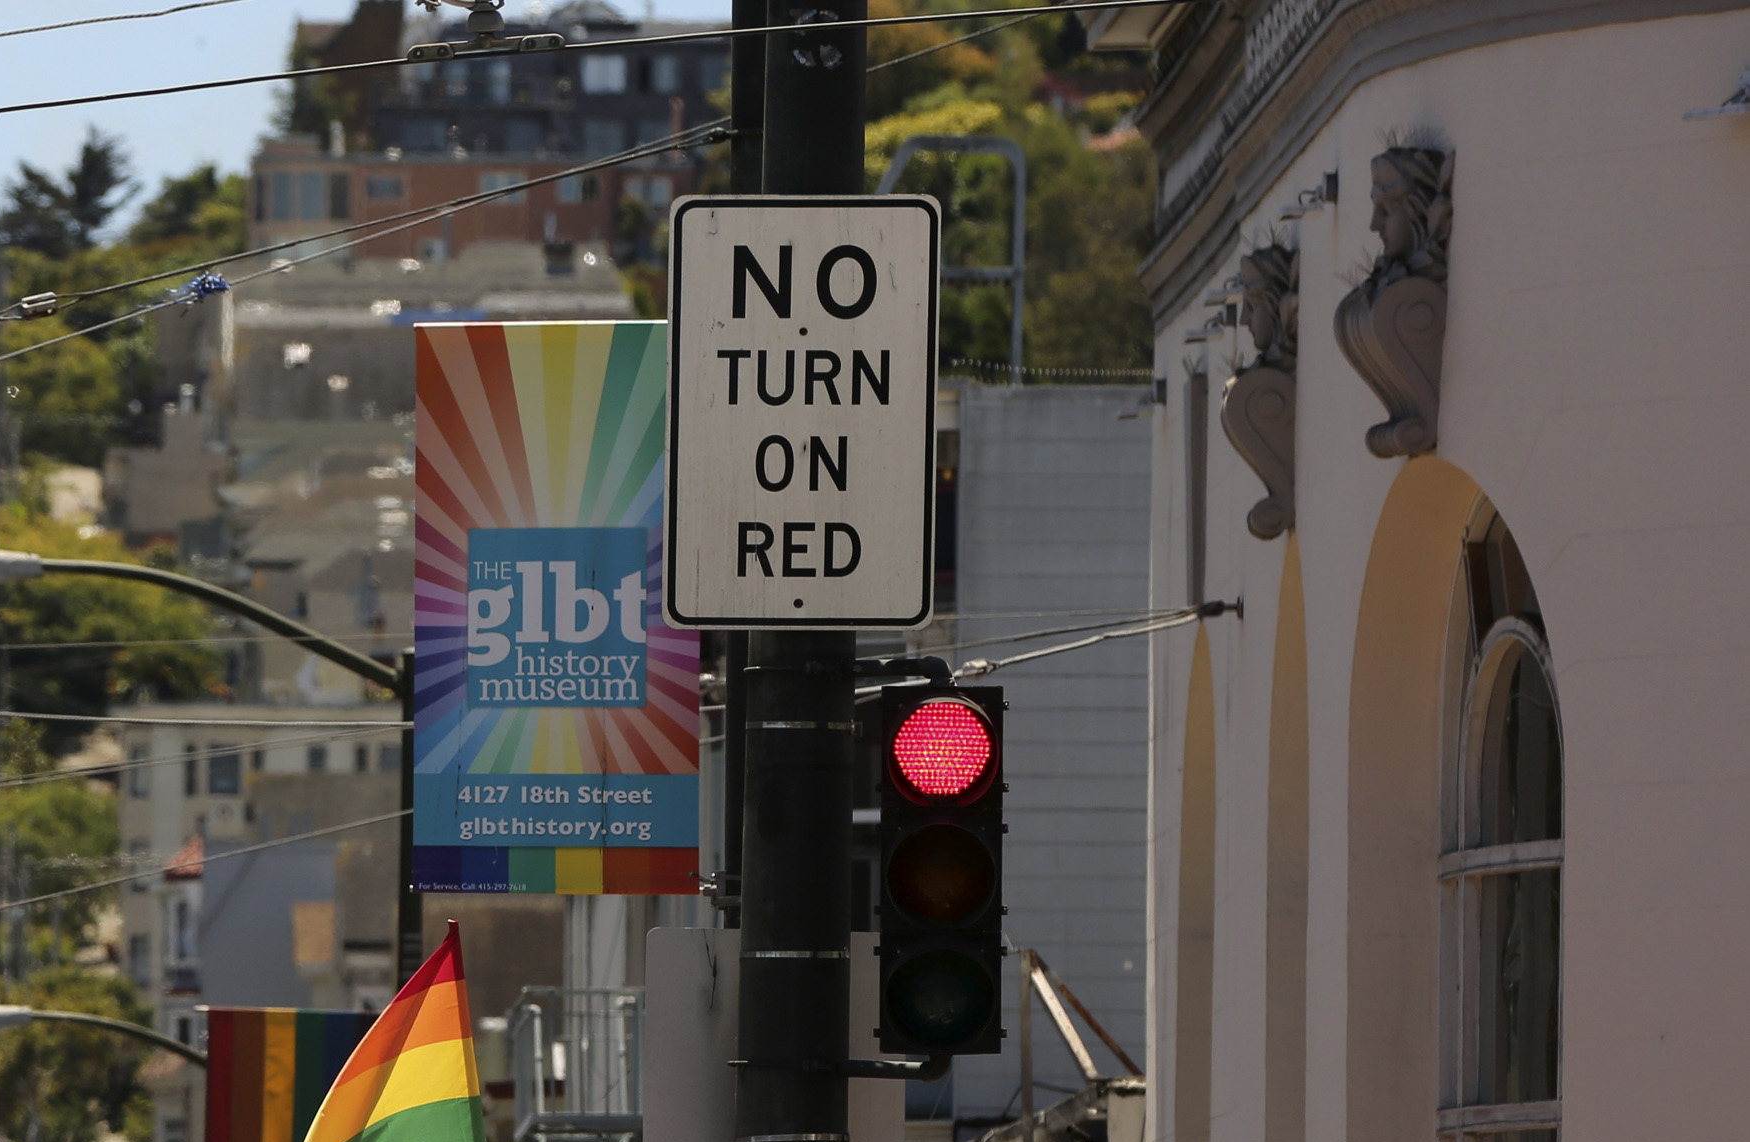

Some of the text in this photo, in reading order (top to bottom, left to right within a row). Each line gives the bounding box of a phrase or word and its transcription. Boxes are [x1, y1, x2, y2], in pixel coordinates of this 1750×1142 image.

[732, 244, 877, 320] NO
[717, 349, 890, 406] TURN
[755, 434, 848, 492] ON
[737, 521, 862, 577] RED
[473, 561, 512, 580] THE
[467, 561, 647, 667] glbt
[515, 646, 640, 680] history
[479, 677, 639, 700] museum
[458, 785, 653, 804] 4127 18th Street
[459, 817, 652, 841] glbthistory.org
[418, 882, 431, 890] For
